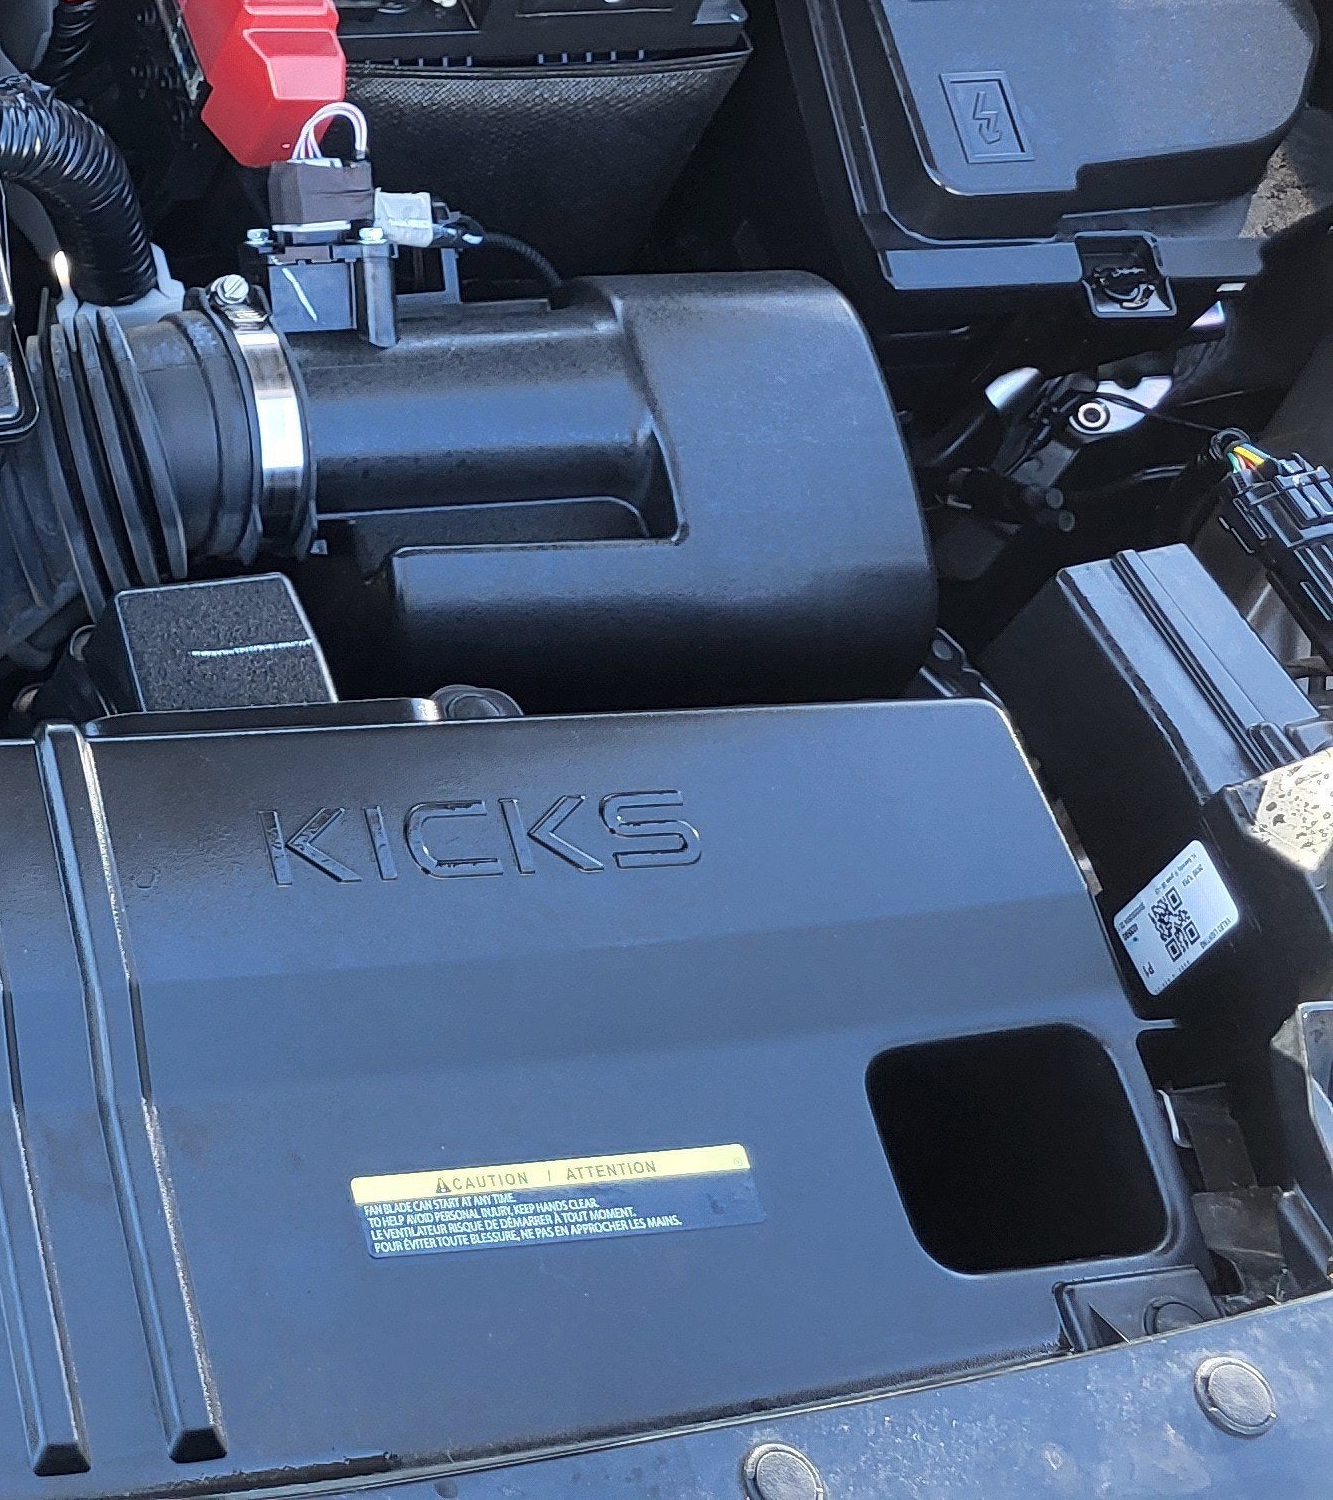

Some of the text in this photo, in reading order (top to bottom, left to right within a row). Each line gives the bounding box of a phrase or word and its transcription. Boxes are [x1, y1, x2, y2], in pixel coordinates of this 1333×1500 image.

[257, 789, 702, 887] KICKS
[452, 1160, 657, 1191] CAUTION ATTENTION
[364, 1193, 516, 1216] FAN BLADE CAN START AT ANY TIME.
[367, 1197, 599, 1229] TO HELP AVOID PERSONAL INJURY, KEEP HANDS CLEAR.
[370, 1206, 636, 1240] LE VENTILATEUR RISQUE DE DÉMARRER À TOUT MOMENT.
[374, 1214, 682, 1253] POUR ÉVITER TOUTE BLESSURE, NE PAS EN APPROCHER LES MAINS.
